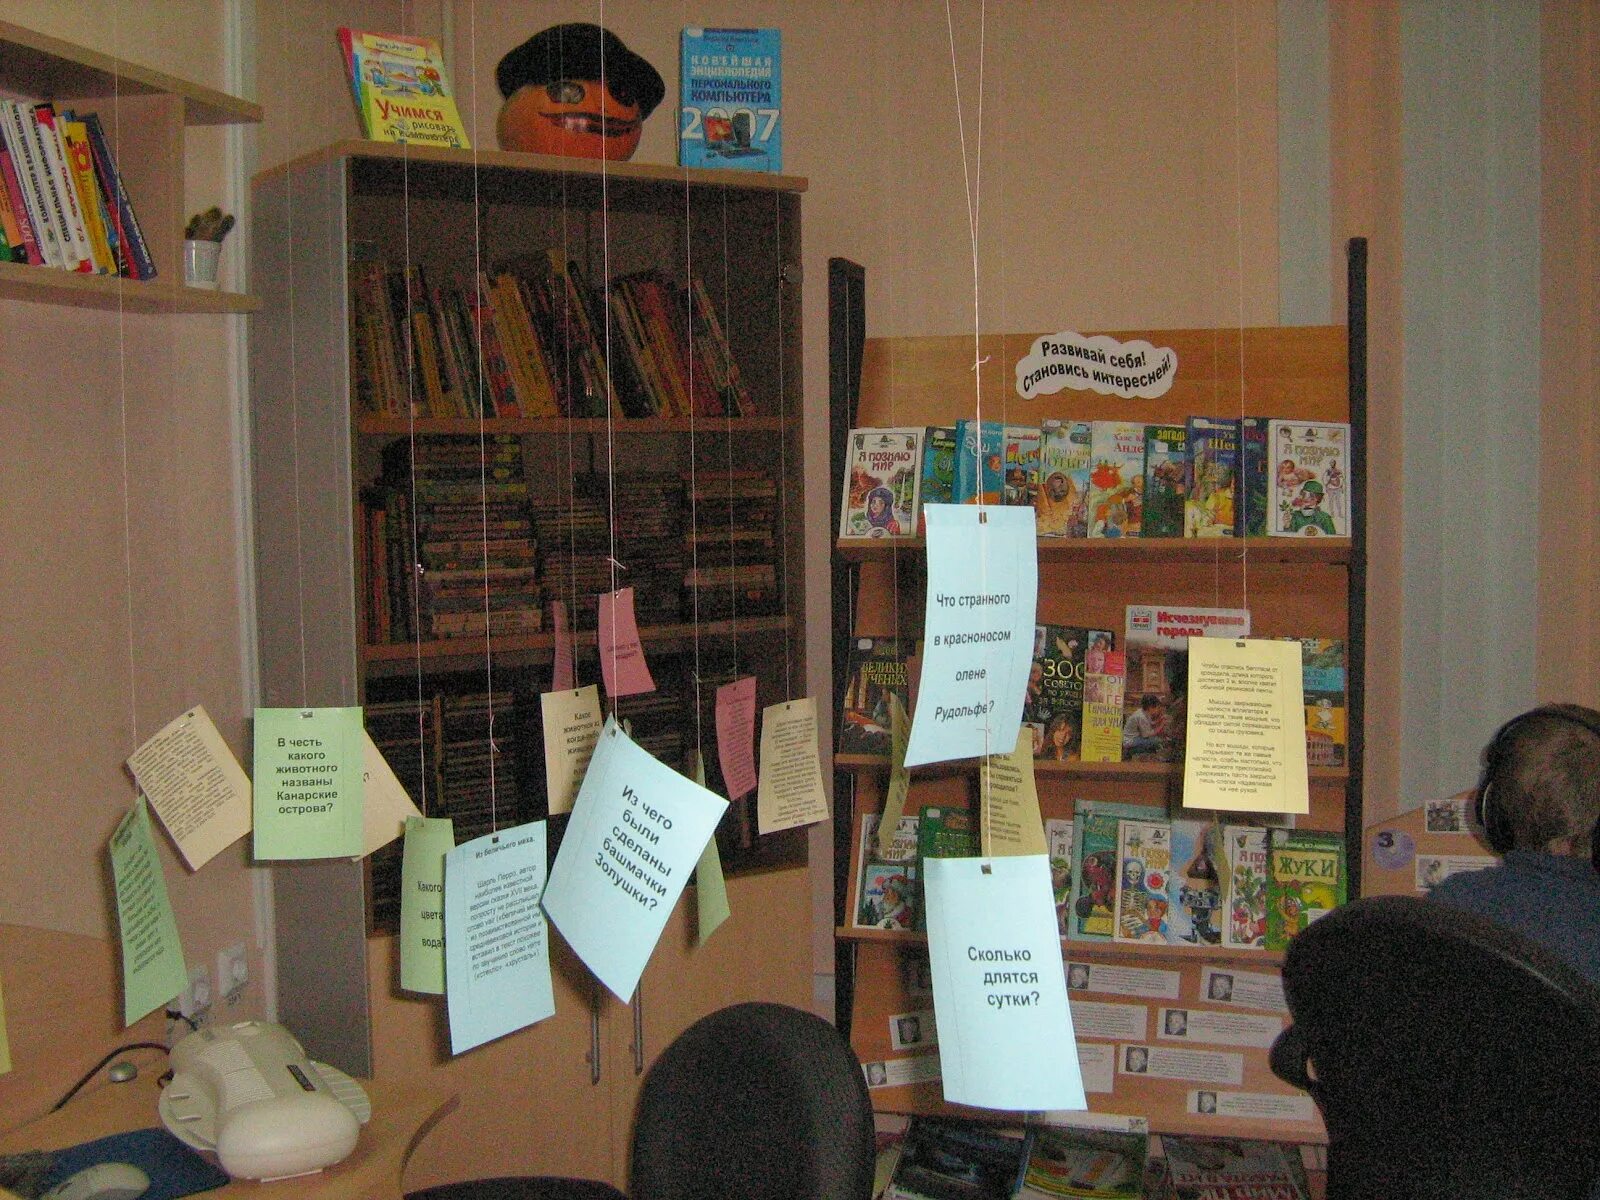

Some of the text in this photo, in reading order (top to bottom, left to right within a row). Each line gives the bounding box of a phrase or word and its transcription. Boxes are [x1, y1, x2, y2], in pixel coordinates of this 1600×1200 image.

[690, 67, 772, 78] ЭНЦИКЛОПЕДИЯ
[691, 79, 771, 90] ПЕРСОНАЛЬНОГО
[691, 91, 771, 102] КОМПЬЮТЕРА
[375, 99, 443, 120] Учимся
[412, 121, 456, 133] рисовать
[29, 108, 53, 177] ИНФОРМАТИКА
[30, 169, 49, 223] КОМПЬЮТЕР
[61, 166, 78, 217] ПАСКАЛЬ
[47, 180, 71, 242] СПЕЦИАЛЬНАЯ
[20, 217, 33, 243] DOS
[1042, 341, 1146, 369] Развивай себя!
[1023, 353, 1171, 392] Становись интересней!
[859, 451, 911, 462] Я ПОЗНАЮ
[872, 462, 894, 471] МИР
[936, 593, 1010, 609] Что странного
[934, 630, 1011, 646] в красноносом
[955, 667, 986, 682] олене
[935, 700, 995, 721] Рудольфе?
[277, 737, 322, 747] В честь
[288, 751, 326, 760] какого
[276, 764, 338, 774] животного
[282, 778, 332, 787] названы
[276, 791, 338, 802] Канарские
[278, 802, 334, 815] острова?
[622, 785, 673, 830] Из чего
[622, 809, 660, 845] были
[517, 836, 535, 846] меха.
[612, 826, 672, 877] сделаны
[602, 836, 667, 897] башмачки
[1279, 856, 1334, 878] ЖУКИ
[417, 881, 443, 892] Какого
[595, 852, 659, 912] Золушки?
[421, 911, 443, 920] цвета
[968, 946, 1031, 962] Сколько
[984, 971, 1038, 985] длятся
[987, 991, 1040, 1010] сутки?
